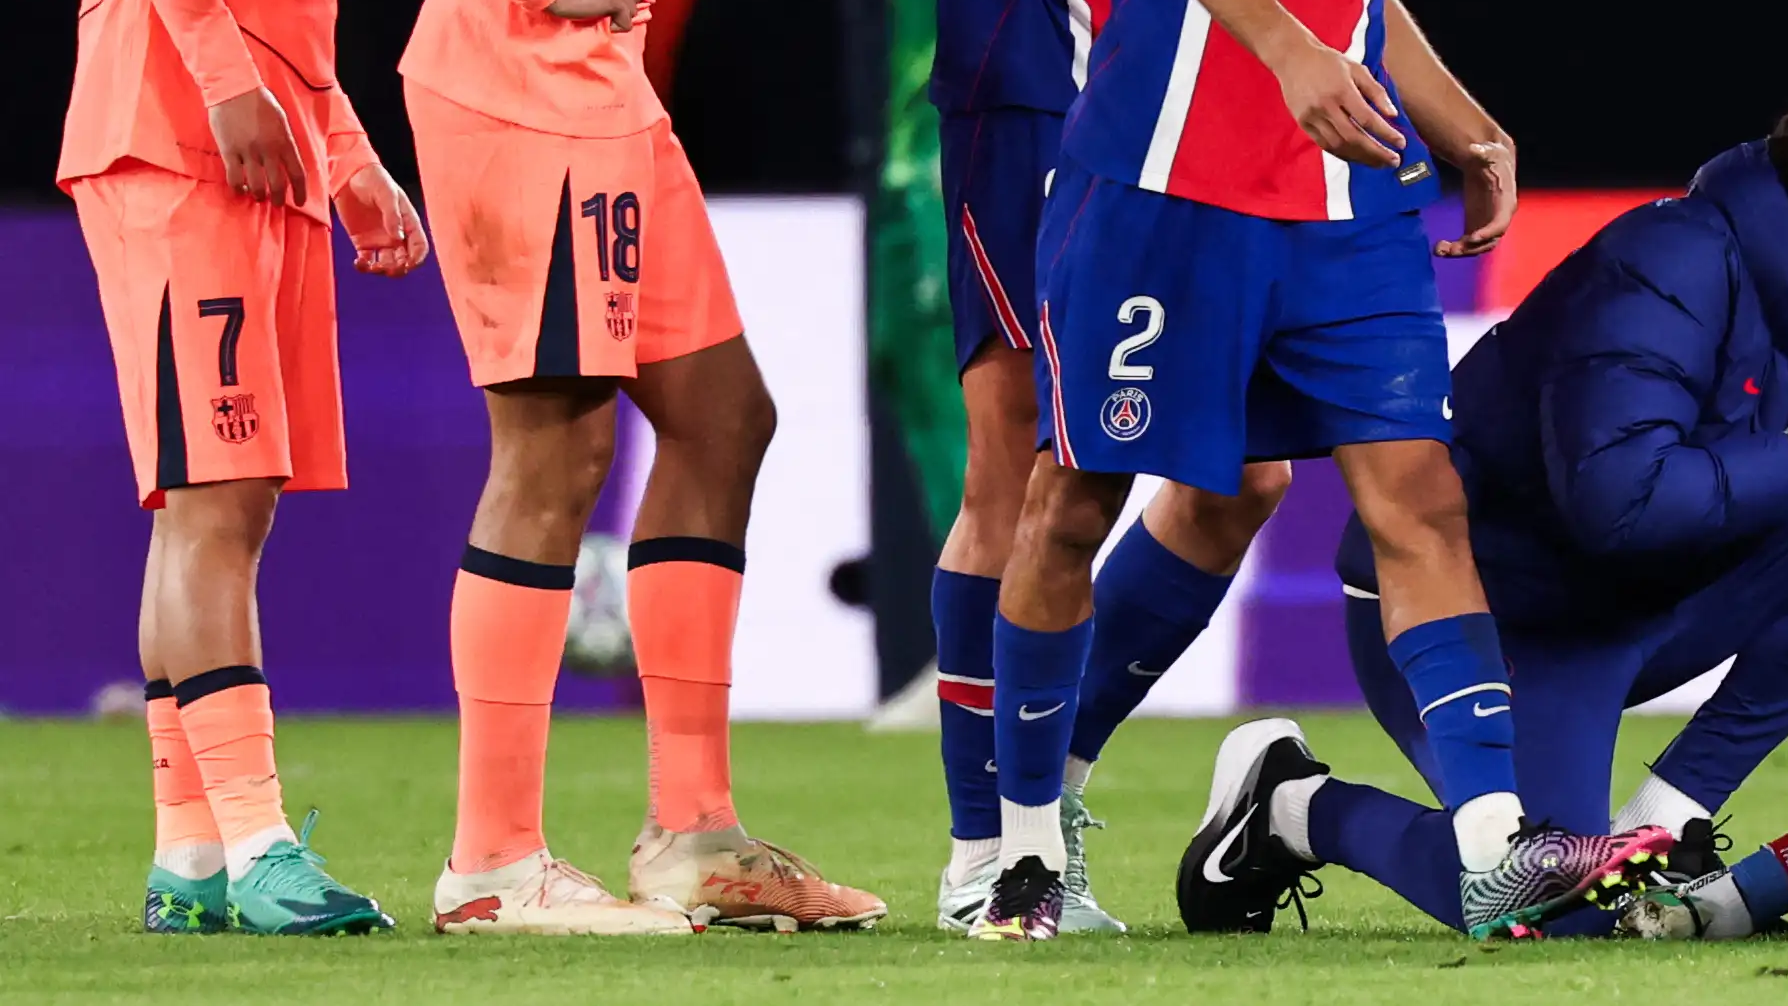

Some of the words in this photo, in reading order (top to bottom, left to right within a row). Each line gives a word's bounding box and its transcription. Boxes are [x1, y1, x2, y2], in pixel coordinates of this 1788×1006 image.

[581, 191, 641, 284] 18
[197, 296, 245, 387] 7
[1108, 295, 1165, 381] 2
[1111, 389, 1145, 404] PARIS
